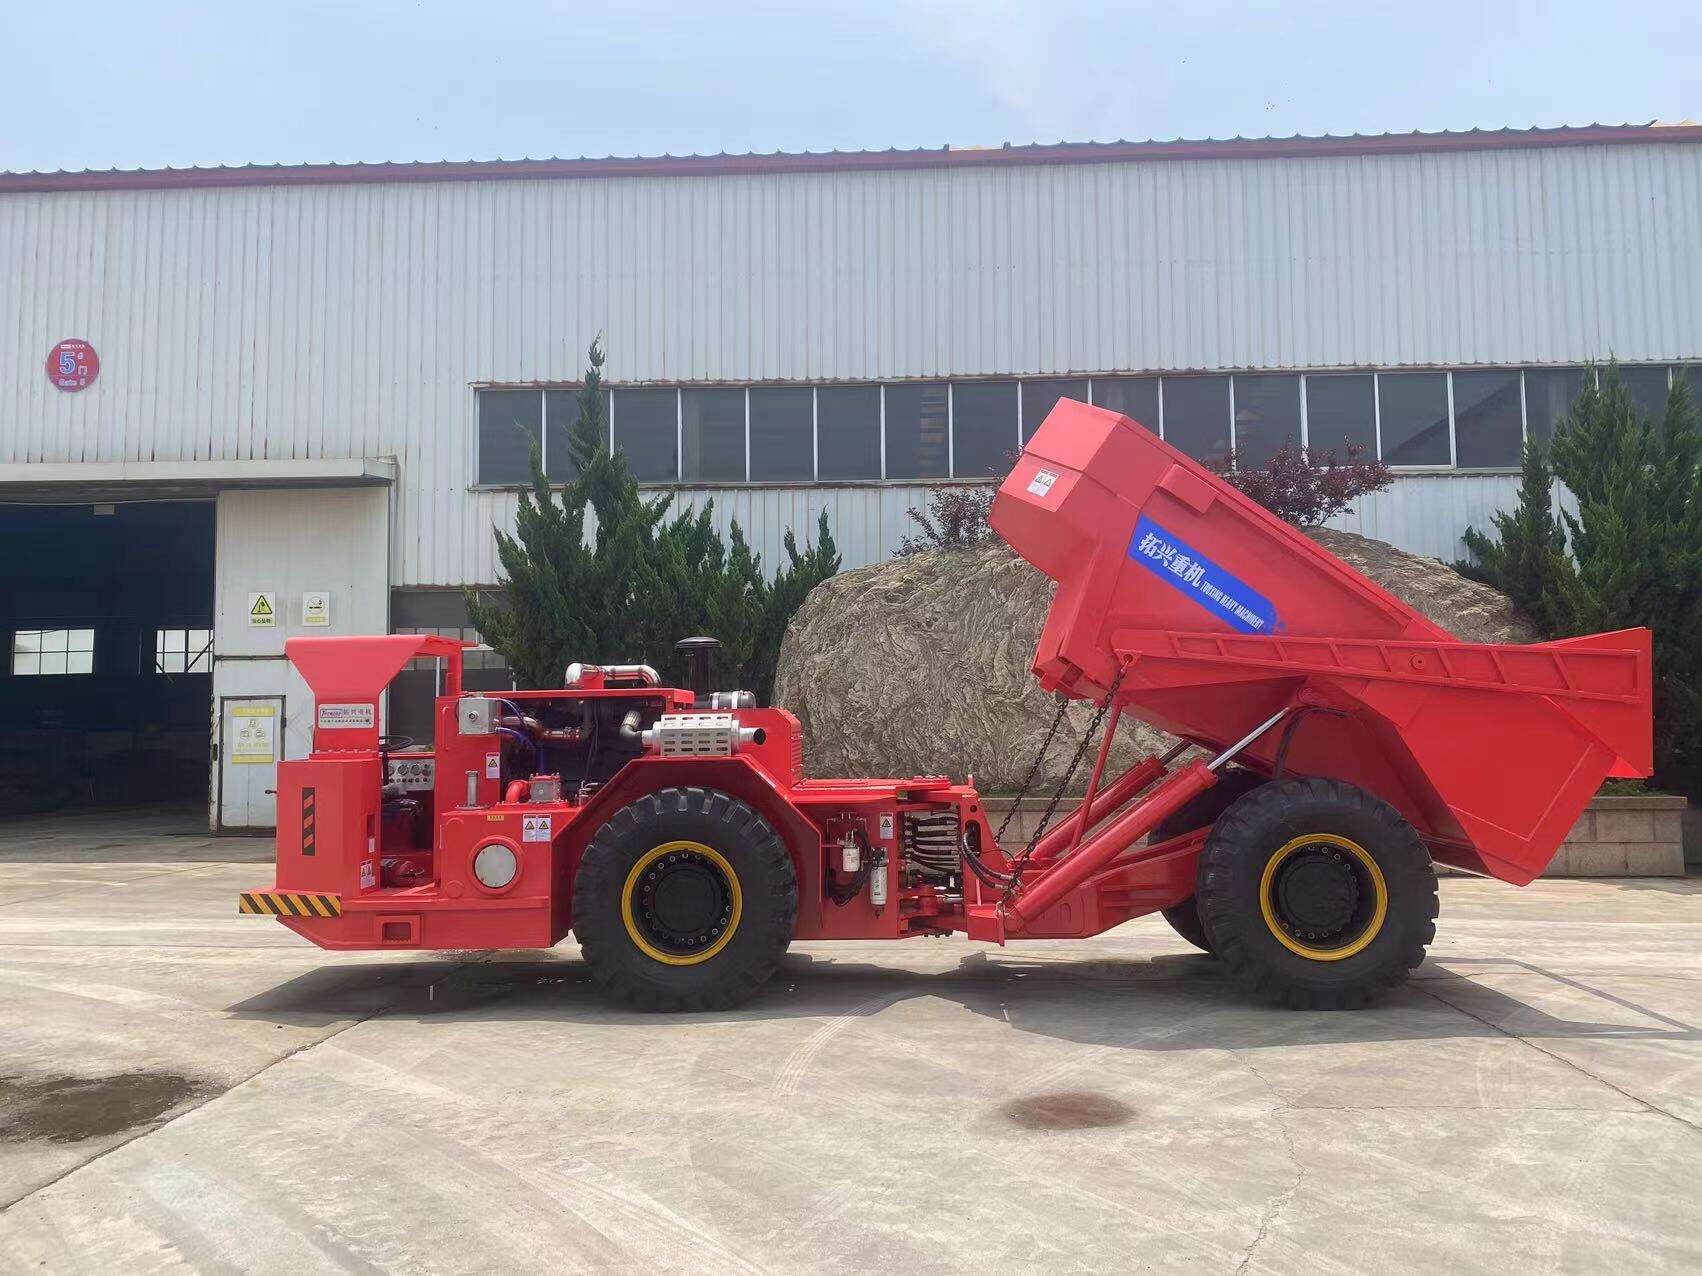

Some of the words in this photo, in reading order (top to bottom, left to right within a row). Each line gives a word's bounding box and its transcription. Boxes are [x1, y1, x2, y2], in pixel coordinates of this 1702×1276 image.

[60, 352, 75, 374] 5
[1139, 532, 1206, 588] 拓兴重机
[1219, 594, 1239, 612] HEAVY
[1234, 605, 1265, 630] MACHINERY
